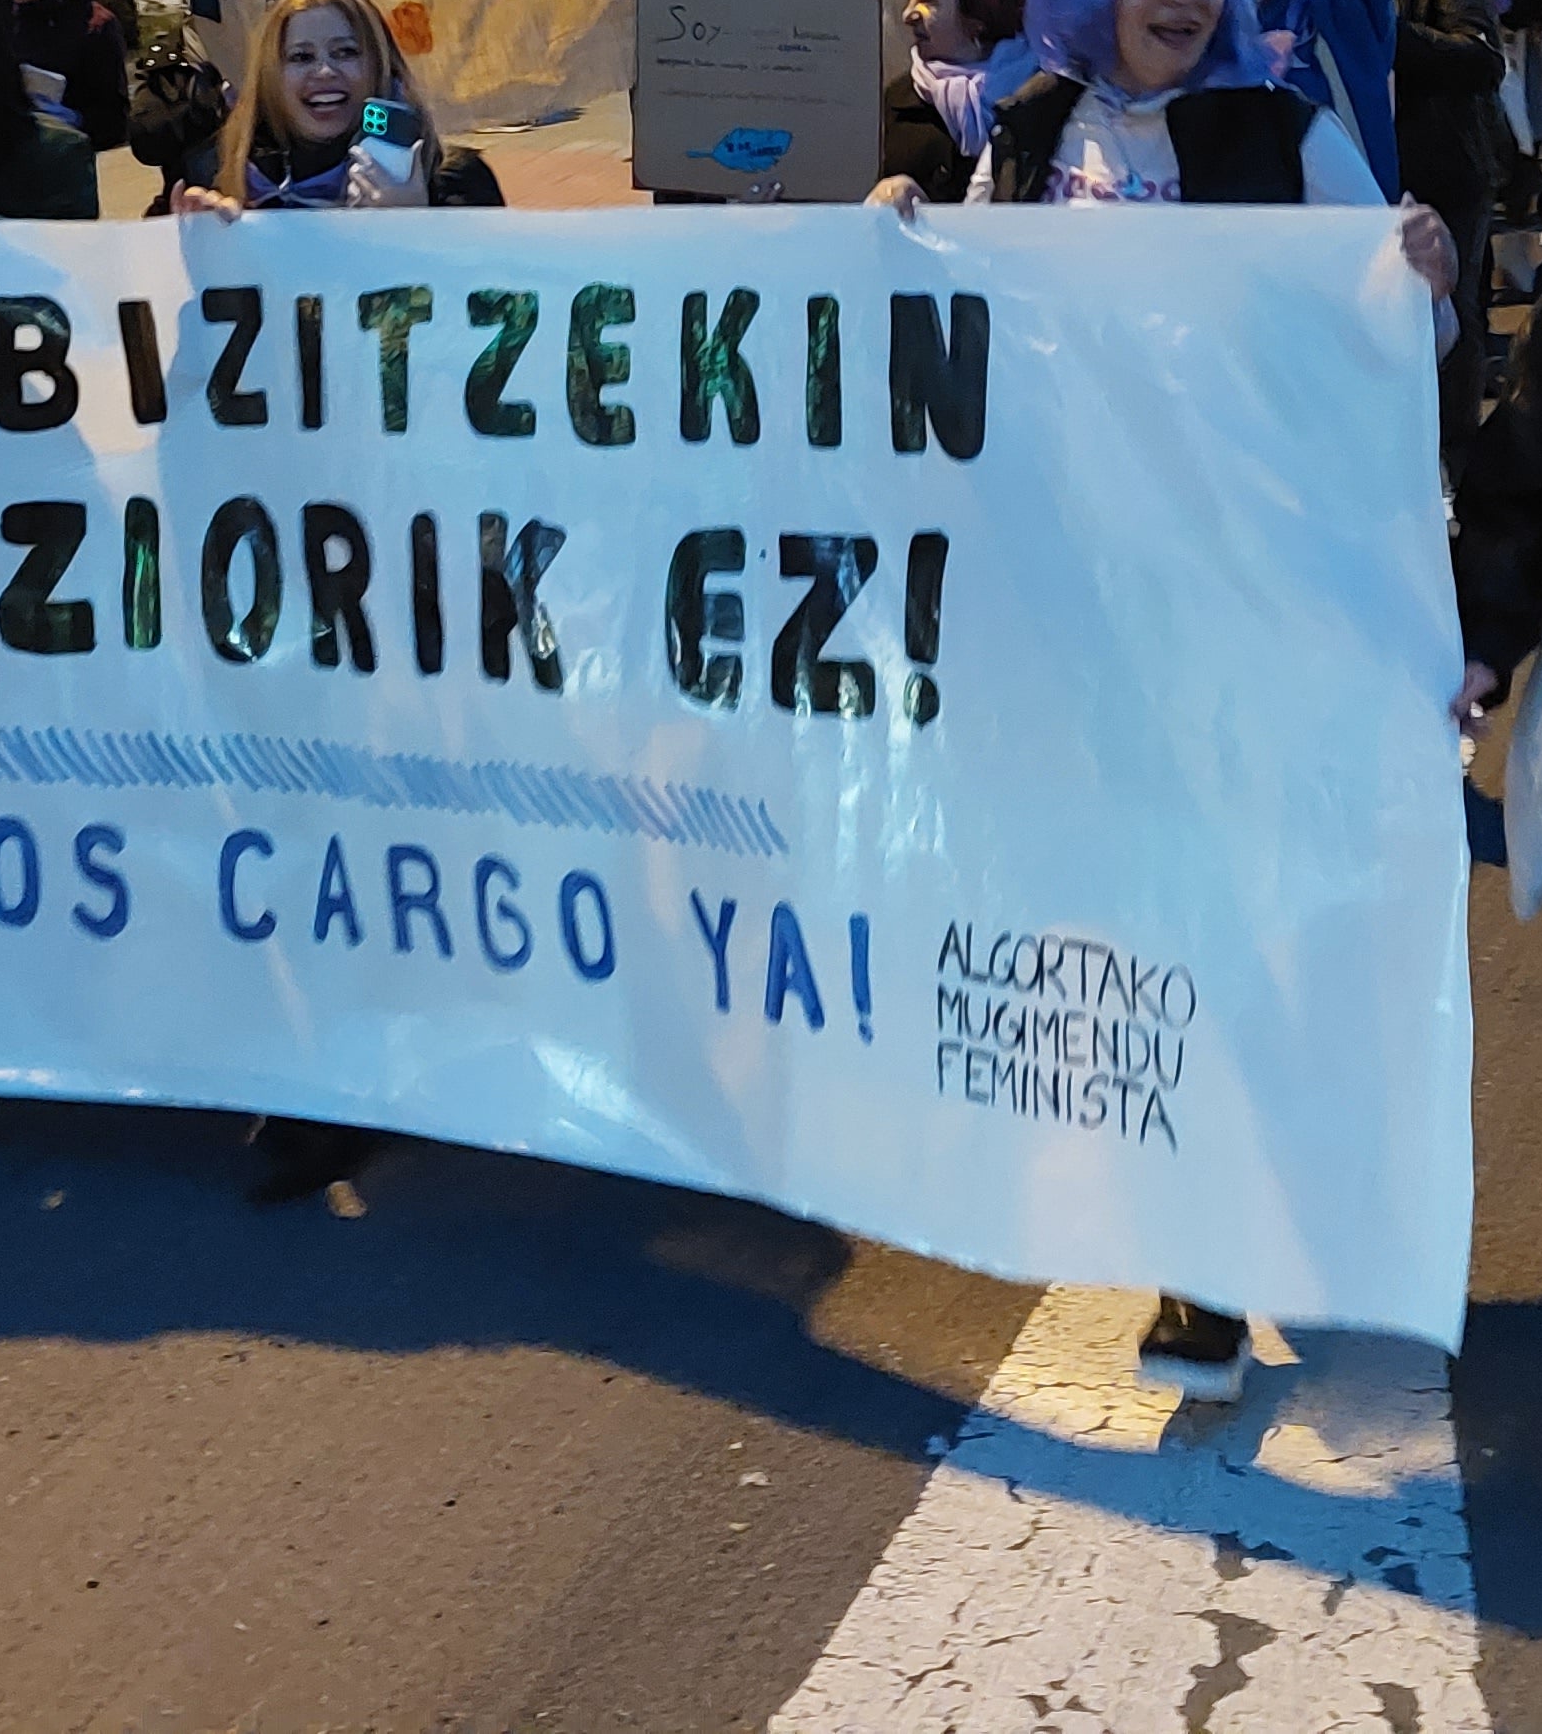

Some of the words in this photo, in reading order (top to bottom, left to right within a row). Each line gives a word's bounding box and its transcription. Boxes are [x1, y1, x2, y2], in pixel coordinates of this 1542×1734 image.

[666, 526, 949, 729] EZ!
[218, 827, 616, 983] CARGO
[692, 886, 875, 1045] YA!
[937, 919, 1197, 1030] ALGORTAKO
[937, 982, 1184, 1091] MUGIMENDU
[937, 1040, 1177, 1154] FEMINISTA
